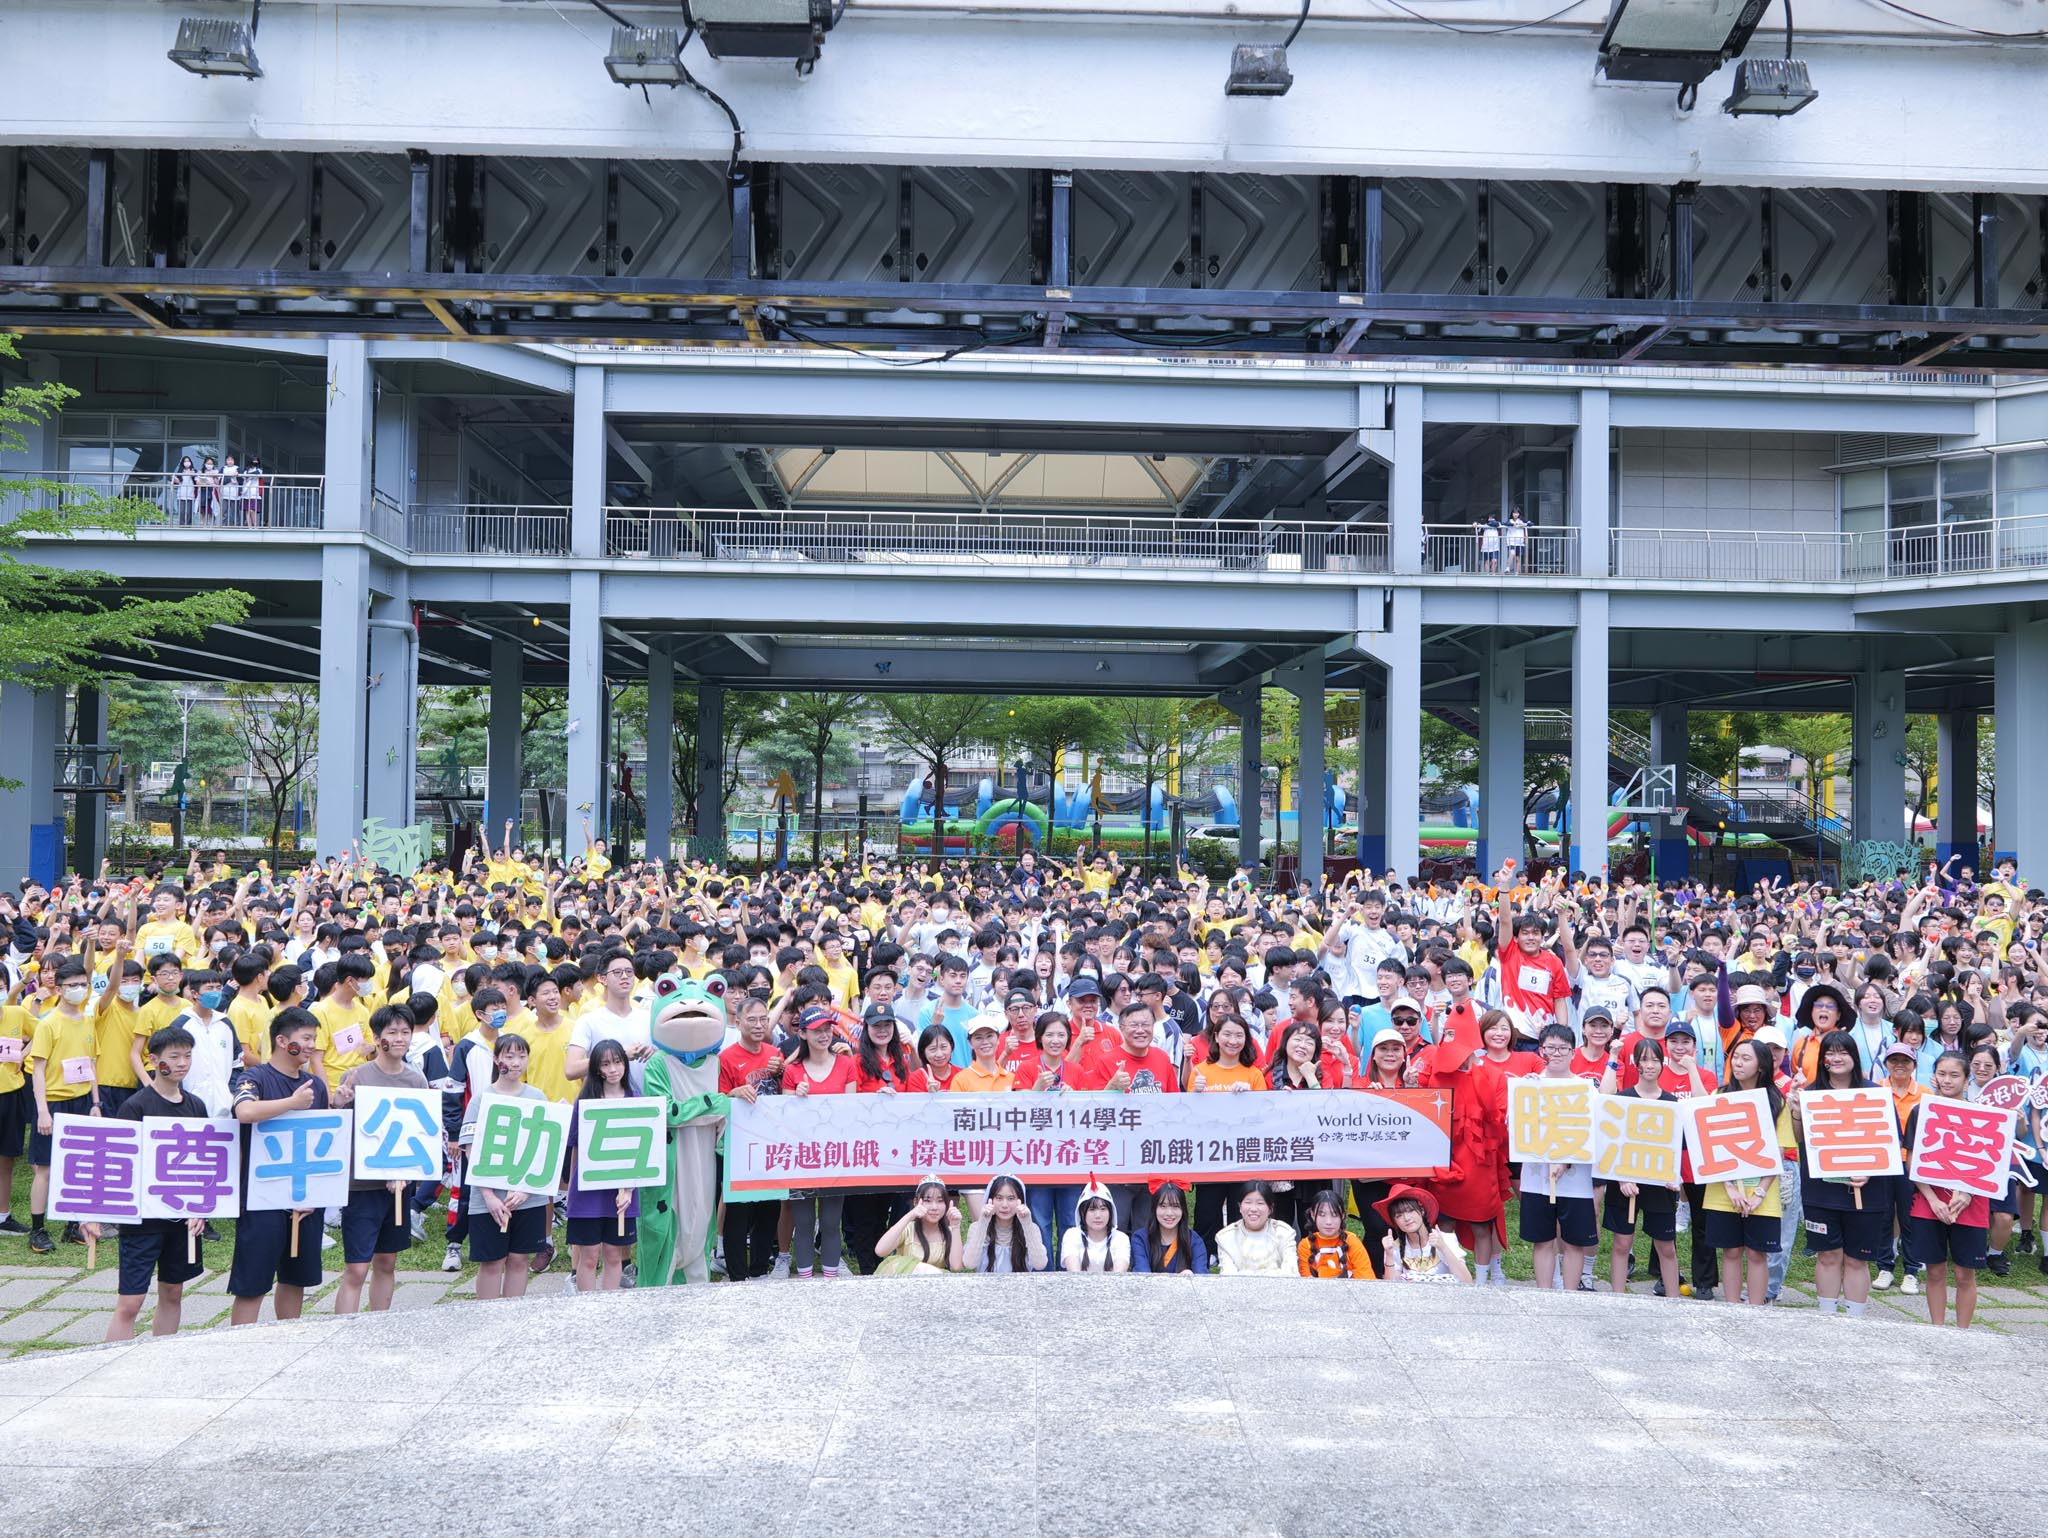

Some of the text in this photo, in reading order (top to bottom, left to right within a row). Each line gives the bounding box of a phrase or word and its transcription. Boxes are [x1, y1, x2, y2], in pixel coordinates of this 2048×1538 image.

[94, 980, 107, 990] 40
[1363, 954, 1376, 965] 33
[1530, 975, 1538, 985] 8
[346, 1034, 354, 1044] 6
[1604, 1000, 1618, 1009] 29
[77, 1065, 83, 1075] 1
[363, 1097, 439, 1176] 公
[472, 1104, 562, 1187] 助
[583, 1106, 660, 1182] 互
[953, 1107, 1142, 1131] 南山中學114學年
[1317, 1112, 1412, 1127] World Vision
[1515, 1085, 1591, 1160] 暖
[1597, 1100, 1676, 1181] 溫
[1696, 1098, 1776, 1176] 良
[1809, 1094, 1892, 1171] 善
[1916, 1102, 2008, 1192] 愛
[55, 1124, 139, 1216] 重
[148, 1123, 234, 1214] 尊
[255, 1115, 344, 1203] 平
